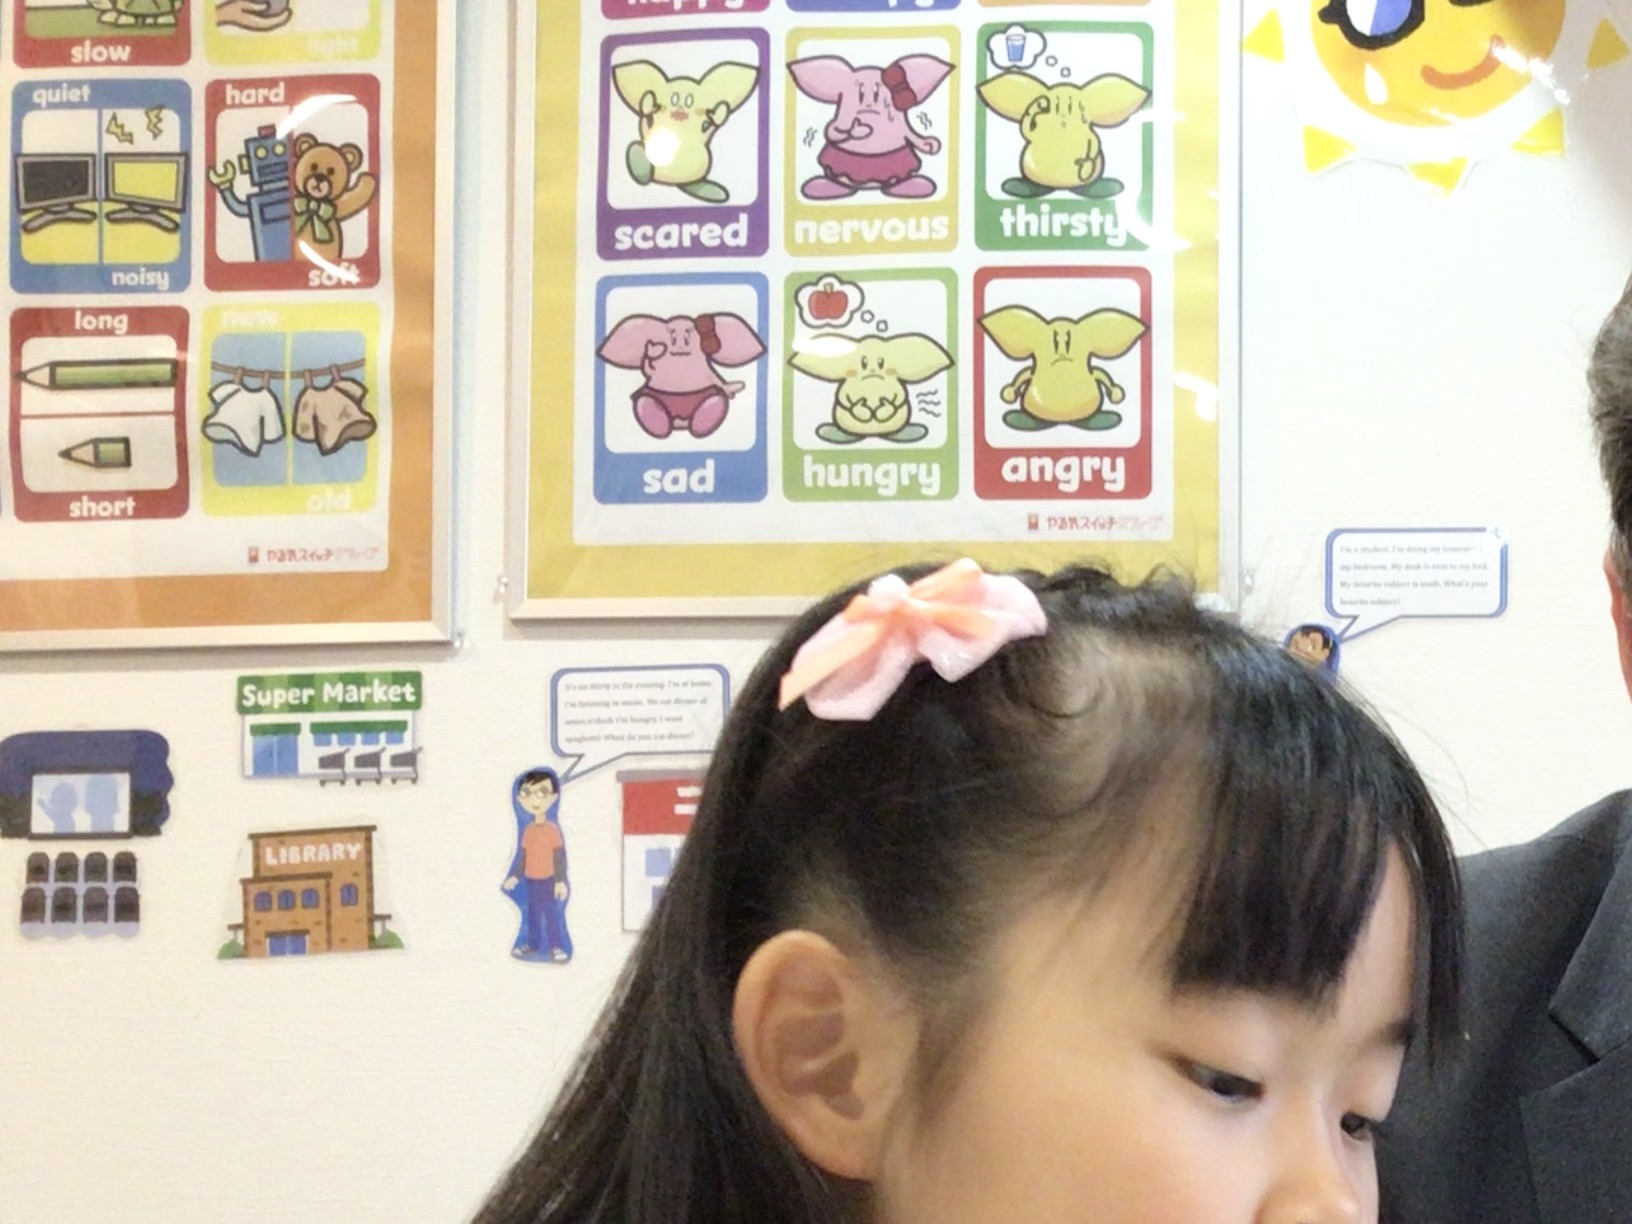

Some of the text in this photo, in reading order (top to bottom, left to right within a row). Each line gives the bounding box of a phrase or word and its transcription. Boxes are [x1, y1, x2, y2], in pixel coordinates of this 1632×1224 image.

[71, 41, 130, 63] slow
[33, 83, 91, 107] quiet
[225, 82, 285, 105] hard
[614, 212, 748, 250] scared
[795, 213, 949, 243] nervous
[1000, 203, 1128, 246] thirsty
[111, 267, 169, 291] noisy
[308, 263, 361, 287] soft
[74, 308, 128, 334] long
[643, 458, 715, 495] sad
[803, 453, 941, 495] hungry
[1001, 454, 1126, 494] angry
[69, 495, 136, 517] short
[306, 490, 350, 512] old
[242, 678, 416, 709] Super Market
[265, 841, 361, 866] LIBRARY
